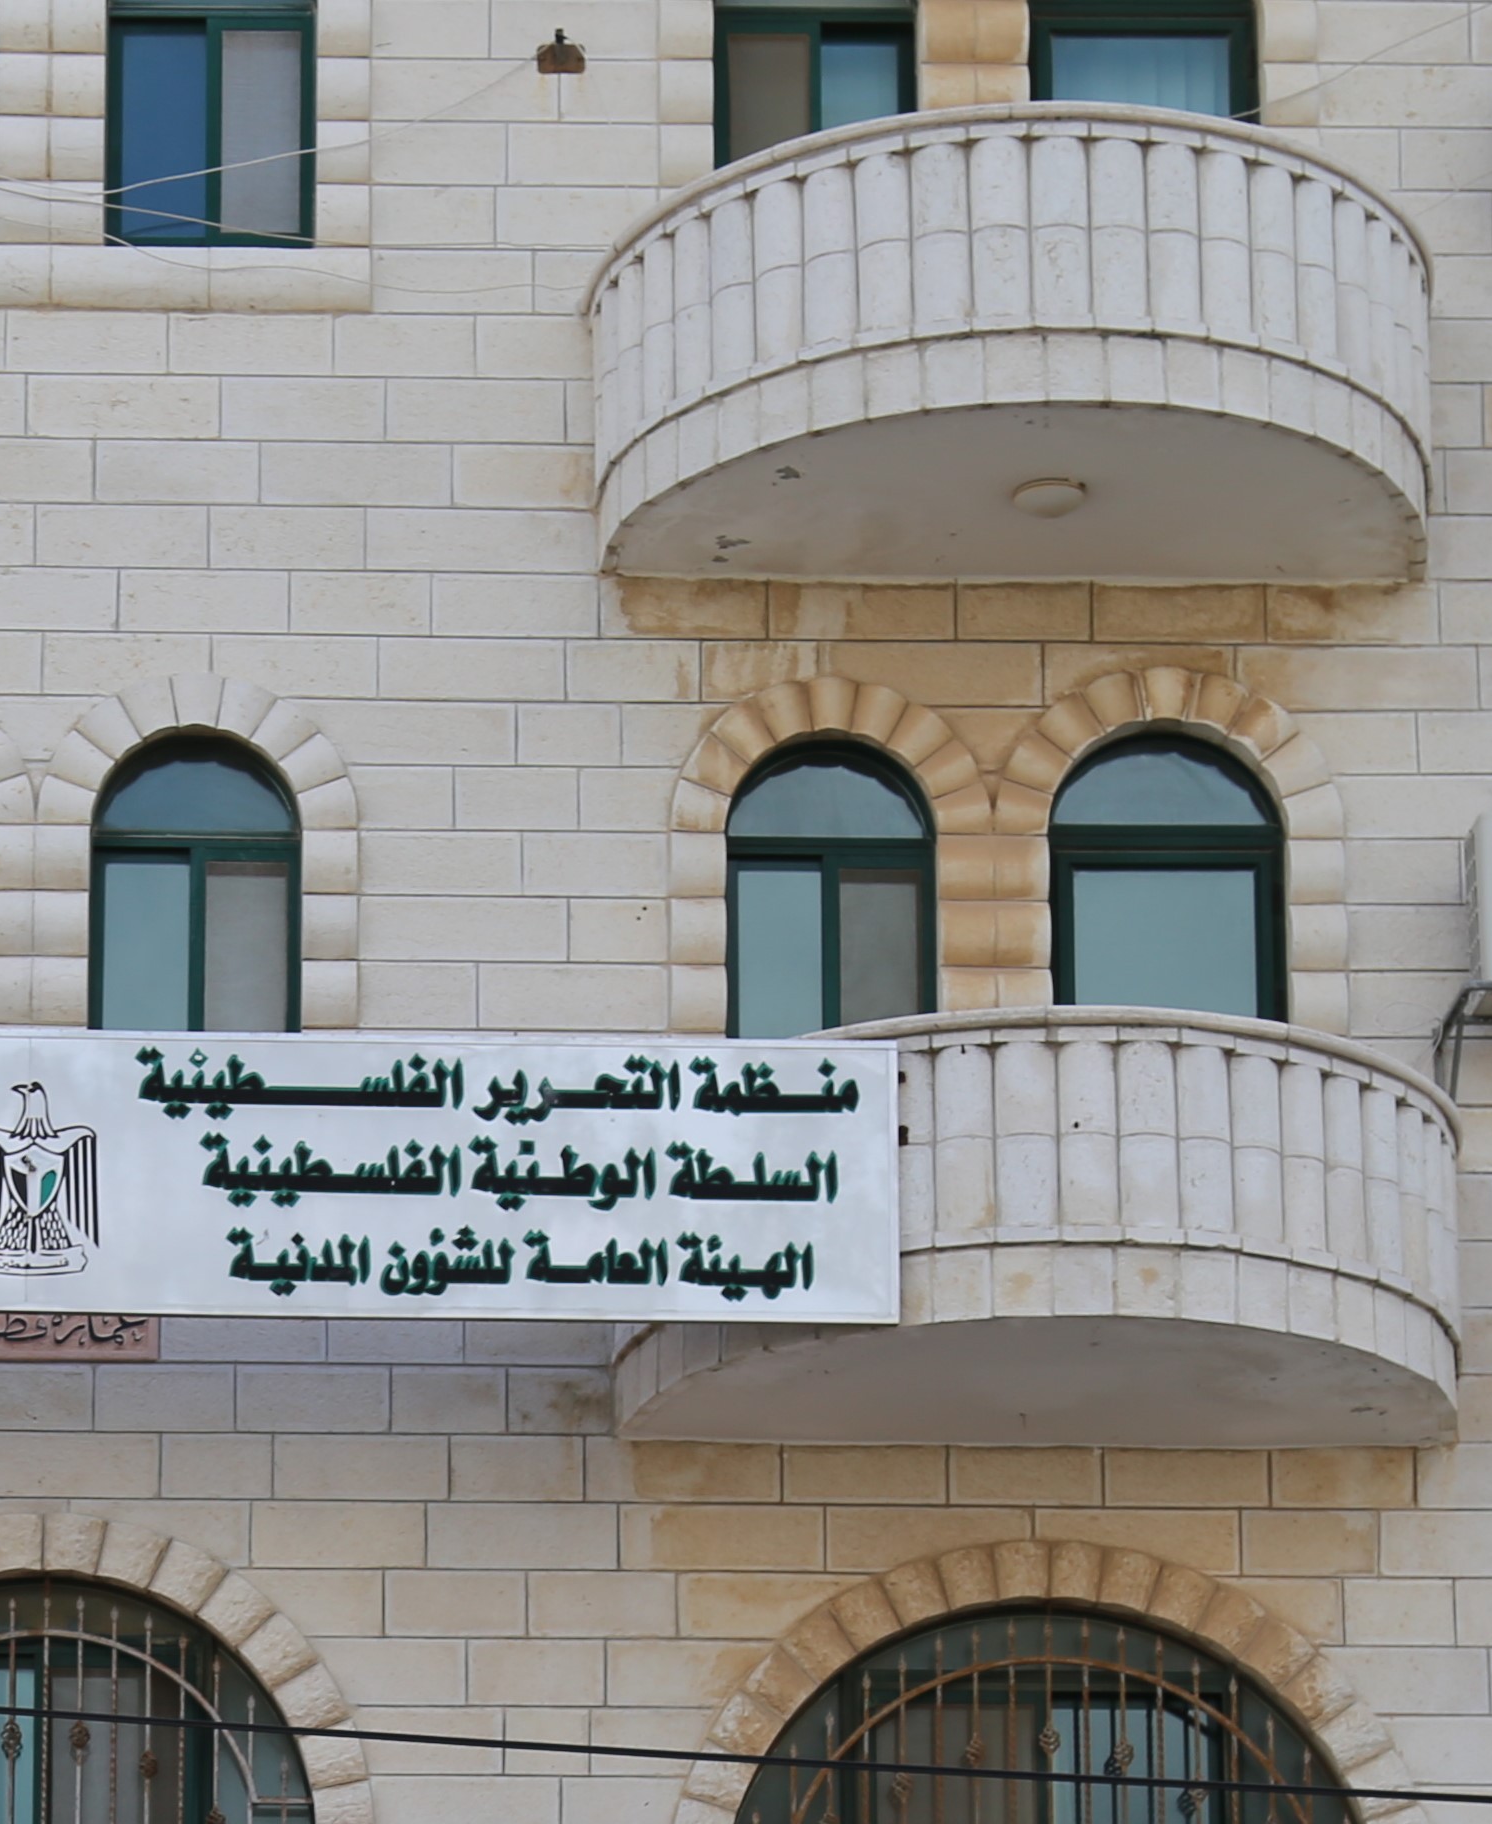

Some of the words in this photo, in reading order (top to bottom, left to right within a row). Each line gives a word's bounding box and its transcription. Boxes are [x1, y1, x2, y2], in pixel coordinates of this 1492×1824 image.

[135, 1046, 465, 1120] الفلسطينية
[472, 1054, 681, 1125] التحرير
[689, 1055, 860, 1117] منظمة
[199, 1131, 463, 1208] الفلسطينية
[468, 1135, 657, 1211] الوطنية
[665, 1140, 839, 1204] السلطة
[225, 1226, 372, 1297] المدنية
[379, 1224, 516, 1297] للشؤون
[522, 1229, 669, 1288] العامة
[676, 1230, 814, 1302] الهيئة
